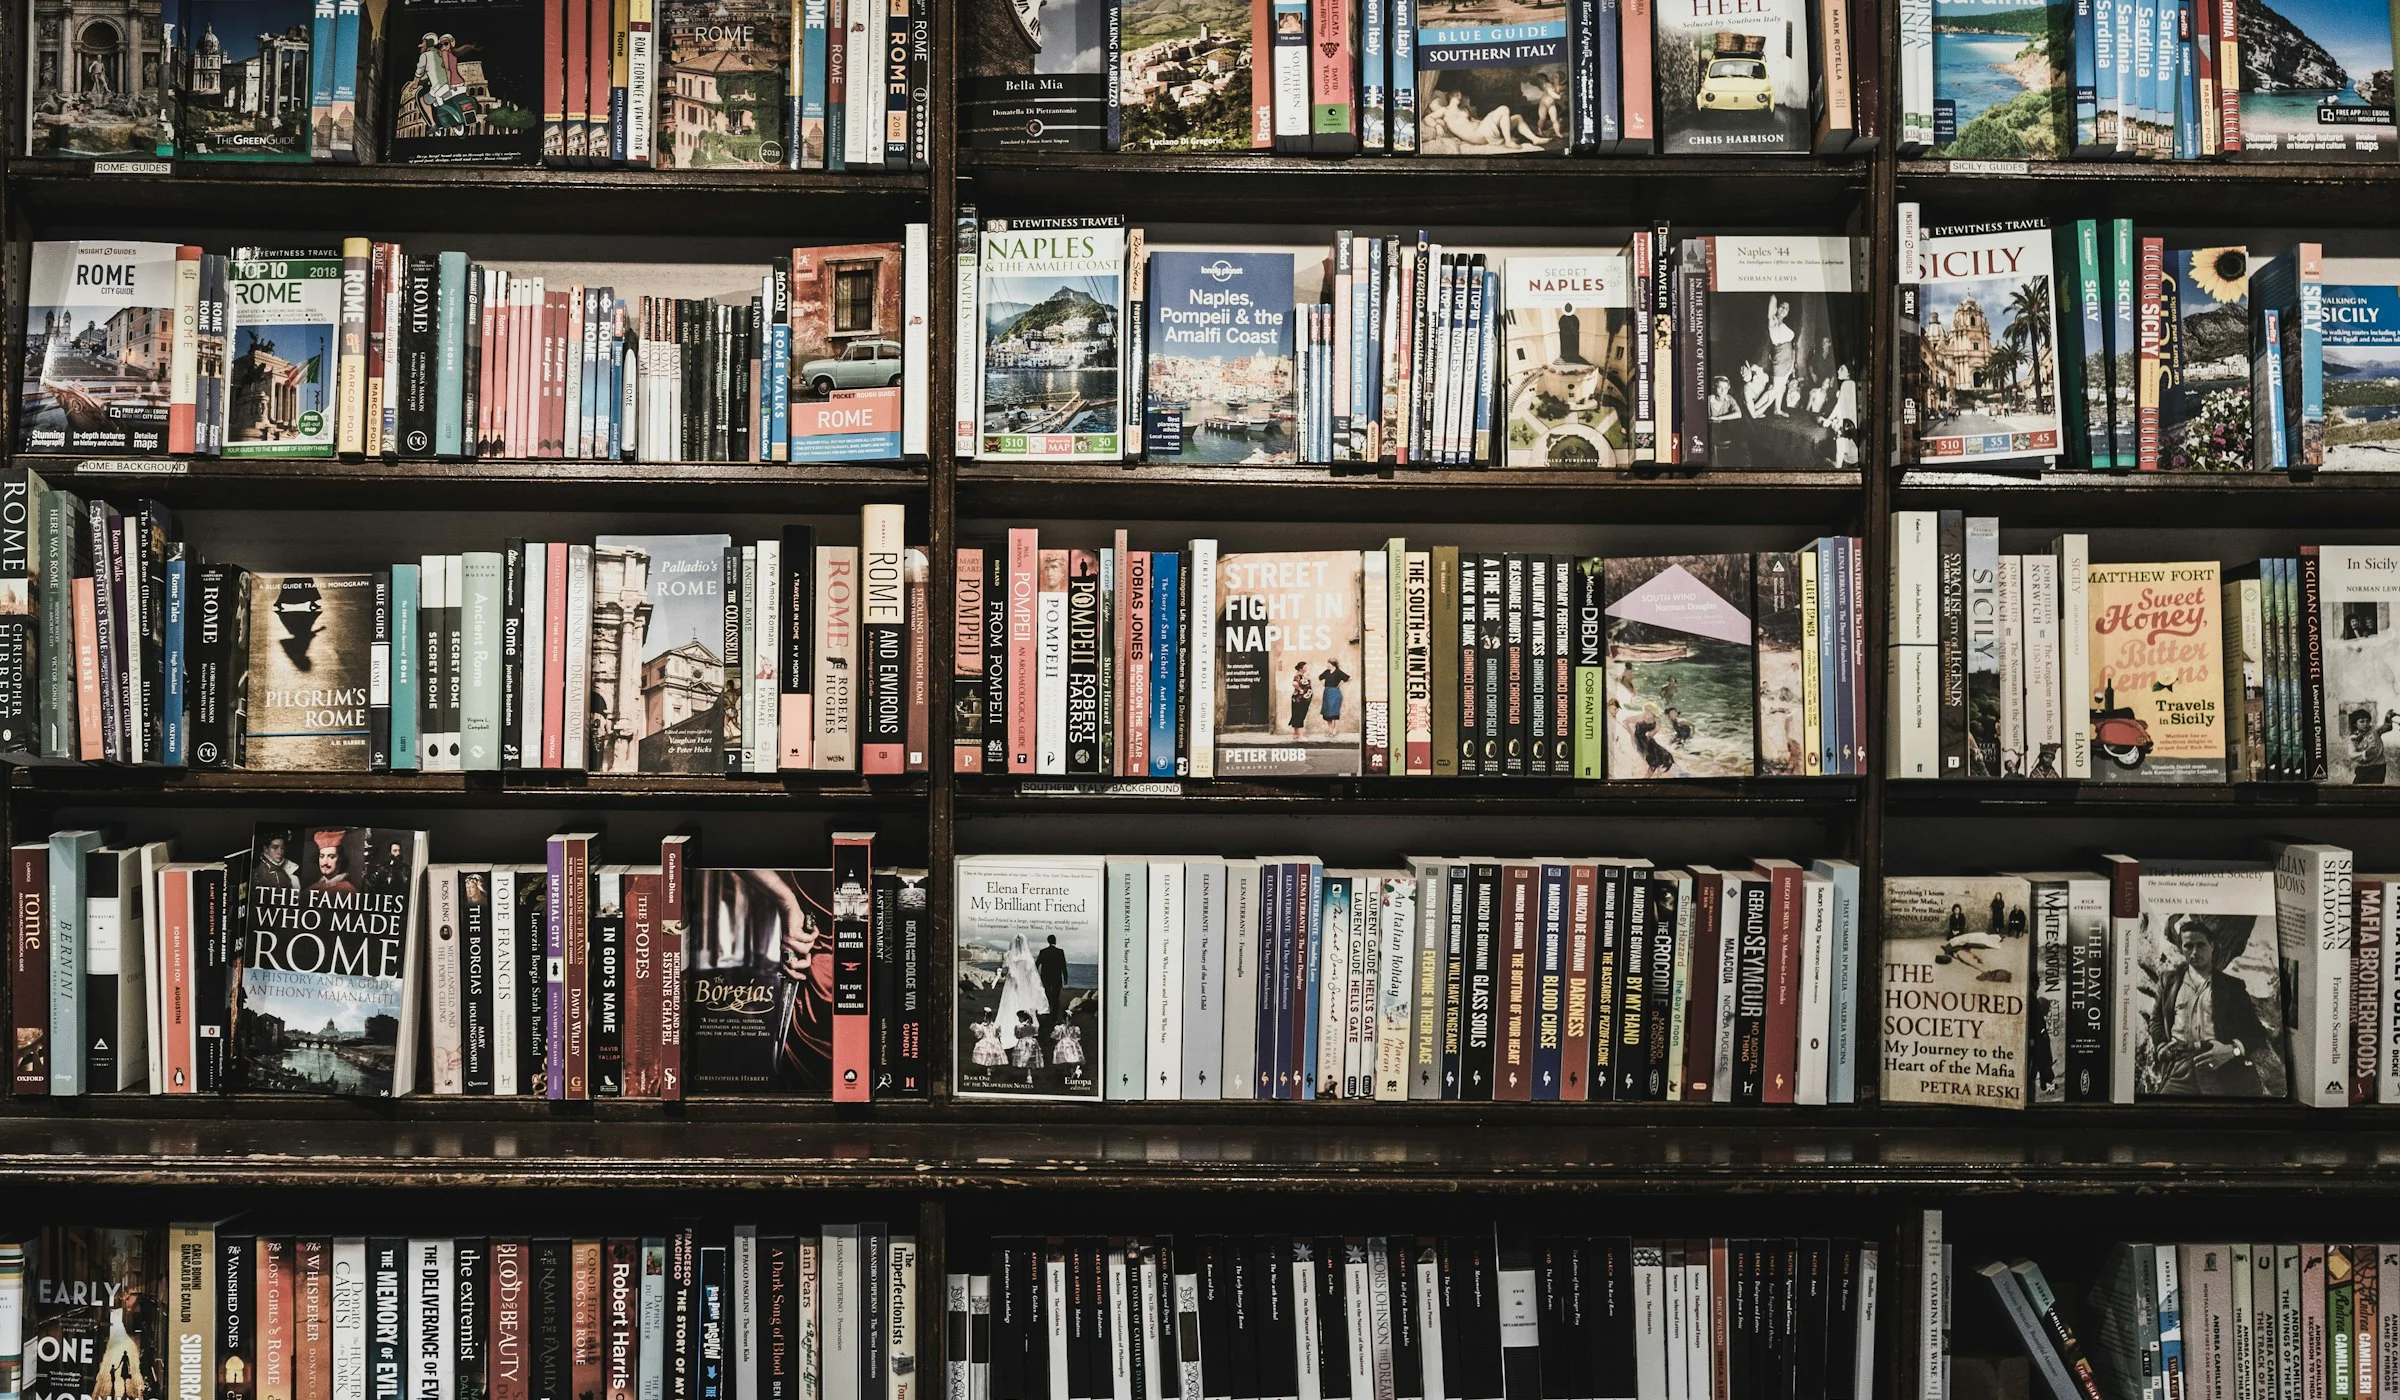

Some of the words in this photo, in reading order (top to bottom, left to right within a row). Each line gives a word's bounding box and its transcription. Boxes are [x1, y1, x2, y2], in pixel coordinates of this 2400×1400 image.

[696, 26, 753, 42] ROME
[1110, 7, 1118, 50] WALKING
[1439, 30, 1480, 42] BLUE
[1491, 25, 1548, 39] GUIDE
[1682, 19, 1713, 28] Seduced
[1715, 19, 1726, 29] by
[1727, 17, 1761, 26] Southern
[1763, 15, 1781, 25] Italy
[2097, 0, 2111, 69] Sardinia
[617, 32, 625, 57] Rome
[1110, 52, 1117, 61] IN
[1430, 48, 1511, 62] SOUTHERN
[1517, 43, 1556, 58] ITALY
[890, 32, 906, 95] ROME
[1006, 79, 1035, 91] Bella
[1040, 79, 1063, 90] Mia
[1108, 63, 1117, 107] ABRUZZO
[1150, 138, 1177, 146] Luciano
[1179, 137, 1188, 146] Di
[1191, 137, 1223, 147] Gregorio
[1689, 136, 1723, 144] CHRIS
[1726, 134, 1784, 143] HARRISON
[97, 163, 129, 172] ROME:
[132, 163, 168, 172] GUIDES
[1953, 162, 1986, 170] SICILY:
[1988, 162, 2024, 171] GUIDES
[1012, 218, 1077, 228] EYEWITNESS
[1080, 216, 1120, 227] TRAVEL
[988, 236, 1094, 259] NAPLES
[1737, 246, 1770, 257] Naples
[77, 265, 135, 285] ROME
[985, 261, 993, 272] &
[997, 261, 1021, 272] THE
[1027, 261, 1075, 272] AMALFI
[1078, 260, 1120, 270] COAST
[1545, 268, 1587, 277] SECRET
[101, 287, 115, 295] CITY
[1189, 289, 1254, 306] Naples,
[1529, 279, 1604, 291] NAPLES
[2117, 280, 2131, 321] SICILY
[413, 277, 428, 333] ROME
[1160, 308, 1230, 328] Pompeii
[1236, 308, 1248, 324] &
[1254, 308, 1283, 324] the
[1165, 326, 1216, 344] Amalfi
[1222, 328, 1277, 345] Coast
[2141, 303, 2159, 358] SICILY
[774, 330, 784, 369] ROME
[774, 375, 784, 419] WALKS
[818, 408, 873, 428] ROME
[82, 462, 114, 471] ROME:
[116, 462, 186, 471] BACKGROUND
[2, 481, 25, 571] ROME
[1225, 561, 1327, 589] STREET
[2347, 558, 2361, 570] In
[2365, 557, 2397, 572] Sicily
[657, 581, 717, 596] ROME
[868, 553, 897, 617] ROME
[1133, 559, 1144, 610] TOBIAS
[202, 586, 218, 644] ROME
[827, 560, 851, 649] ROME
[1225, 594, 1309, 621] FIGHT
[1316, 592, 1341, 618] IN
[1972, 568, 1994, 660] SICILY
[880, 630, 898, 659] AND
[1132, 614, 1143, 660] JONES
[1225, 625, 1331, 652] NAPLES
[1581, 607, 1598, 664] DIBDIN
[825, 674, 835, 734] HUGHES
[838, 677, 847, 732] ROBERT
[880, 665, 898, 734] ENVIRONS
[1069, 673, 1082, 744] HARRIS
[1082, 673, 1095, 744] ROBERT
[2156, 700, 2215, 712] Travels
[304, 709, 366, 727] ROME
[2171, 713, 2215, 727] Sicily
[1225, 749, 1267, 763] PETER
[1271, 748, 1306, 761] ROBB
[1023, 783, 1076, 792] SOUTHERN
[1079, 784, 1109, 792] ITALY:
[1112, 784, 1179, 792] BACKGROUND
[255, 886, 300, 908] THE
[308, 890, 404, 913] FAMILIES
[497, 878, 509, 921] POPE
[986, 881, 1018, 895] Elena
[1022, 882, 1069, 896] Ferrante
[971, 898, 992, 912] My
[996, 897, 1041, 911] Brilliant
[1045, 898, 1086, 912] Friend
[1354, 892, 1362, 929] LAURENT
[2323, 860, 2336, 951] SHADOWS
[2338, 860, 2351, 950] SICILIAN
[2361, 889, 2381, 943] MAFIA
[255, 907, 321, 930] WHO
[329, 911, 400, 936] MADE
[470, 905, 480, 936] THE
[604, 927, 616, 939] IN
[253, 930, 400, 979] ROME
[1352, 932, 1361, 975] GAUDÉ
[2087, 924, 2101, 958] THE
[470, 940, 482, 995] BORGIAS
[498, 928, 511, 1001] FRANCIS
[603, 945, 615, 989] GOD'S
[1886, 963, 1933, 984] THE
[2072, 945, 2085, 1010] BATTLE
[1350, 980, 1359, 1012] HELL'S
[1473, 975, 1489, 1009] GLASS
[1543, 975, 1559, 1011] BLOOD
[2089, 967, 2102, 1002] DAY
[603, 995, 615, 1034] NAME
[1885, 989, 2023, 1016] HONOURED
[2357, 946, 2381, 1079] BROTHERHOODS
[1350, 1015, 1358, 1043] GATE
[1471, 1012, 1486, 1048] SOULS
[1540, 1013, 1558, 1049] CURSE
[1885, 1016, 1984, 1040] SOCIETY
[2088, 1007, 2101, 1031] OF
[1885, 1041, 1908, 1059] My
[1913, 1041, 1970, 1061] Journey
[1974, 1044, 1989, 1058] to
[1993, 1045, 2014, 1059] the
[1921, 1081, 1973, 1096] PETRA
[1976, 1084, 2021, 1100] RESKI
[382, 1250, 393, 1268] THE
[460, 1249, 480, 1270] the
[905, 1252, 915, 1268] The
[39, 1280, 121, 1307] EARLY
[227, 1256, 240, 1309] VANISHED
[306, 1254, 320, 1342] WHISPERER
[612, 1264, 630, 1326] Robert
[892, 1248, 906, 1346] Imperfectionists
[376, 1272, 398, 1342] MEMORY
[461, 1274, 479, 1360] extremist
[228, 1313, 238, 1348] ONES
[37, 1336, 94, 1364] ONE
[383, 1348, 392, 1359] OF
[612, 1331, 628, 1389] Harris
[2335, 1333, 2348, 1395] CAMILLERI
[2358, 1332, 2372, 1394] CAMILLERI
[377, 1363, 397, 1399] EVIL
